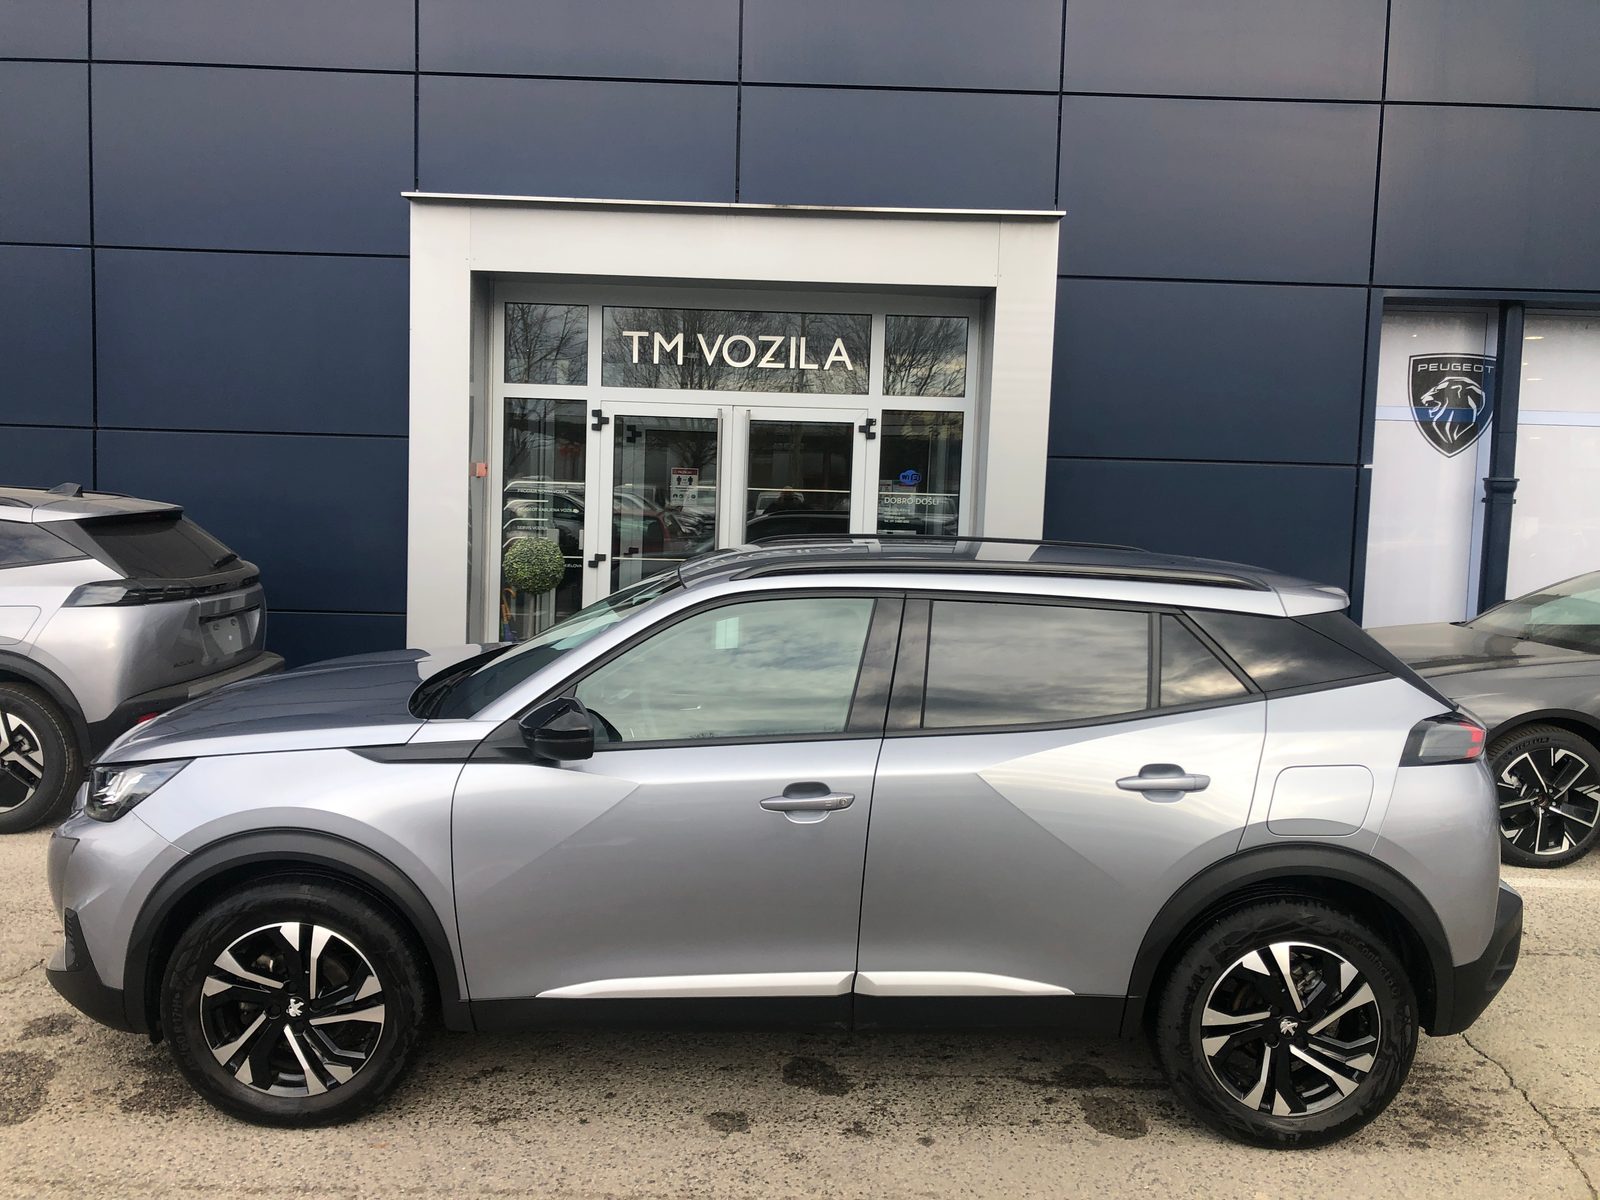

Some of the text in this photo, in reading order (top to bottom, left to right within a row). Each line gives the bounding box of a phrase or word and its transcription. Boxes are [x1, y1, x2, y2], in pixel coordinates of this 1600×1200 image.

[622, 330, 854, 371] TM VOZILA
[1417, 362, 1495, 373] PEUGEOT
[884, 496, 939, 506] DOBRO DOŠLI
